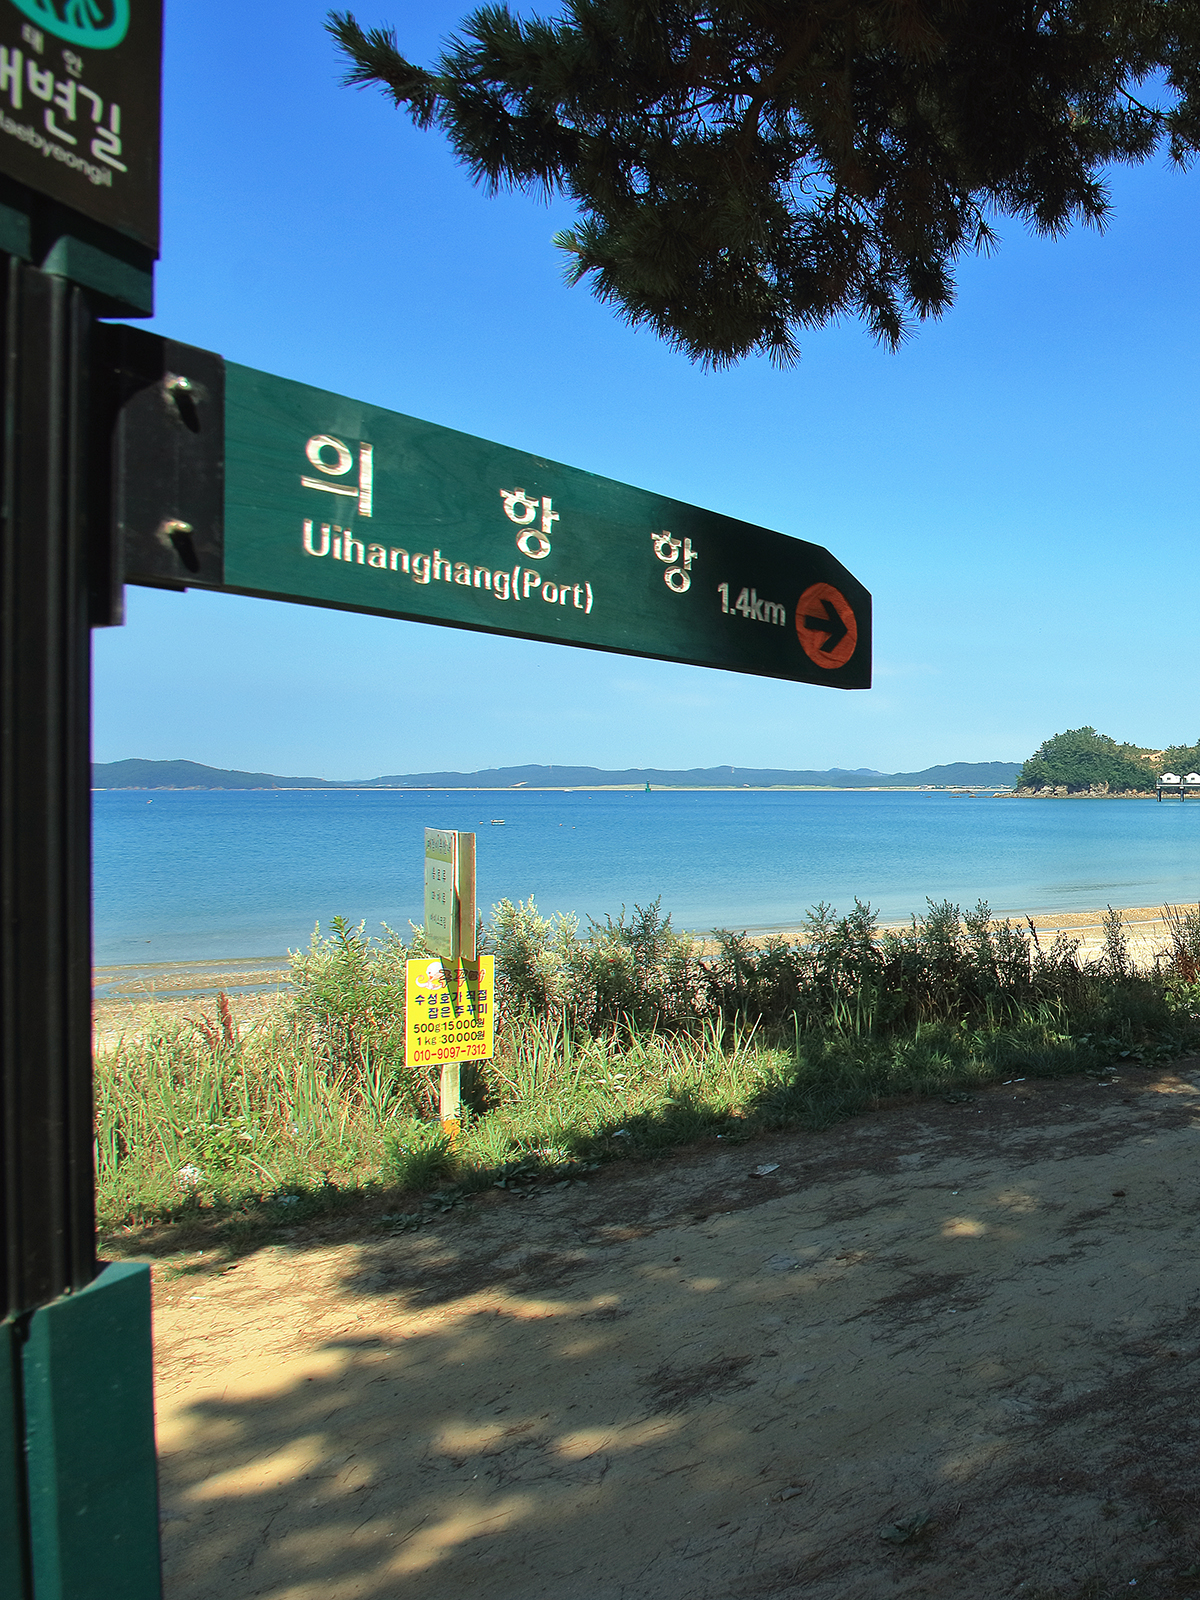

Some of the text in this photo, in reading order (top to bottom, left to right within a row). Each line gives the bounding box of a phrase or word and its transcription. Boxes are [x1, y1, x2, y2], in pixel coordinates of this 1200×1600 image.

[302, 519, 595, 615] Uihanghang(Port)
[717, 582, 787, 628] 1.4km
[413, 1043, 487, 1062] 010-9097-7312
